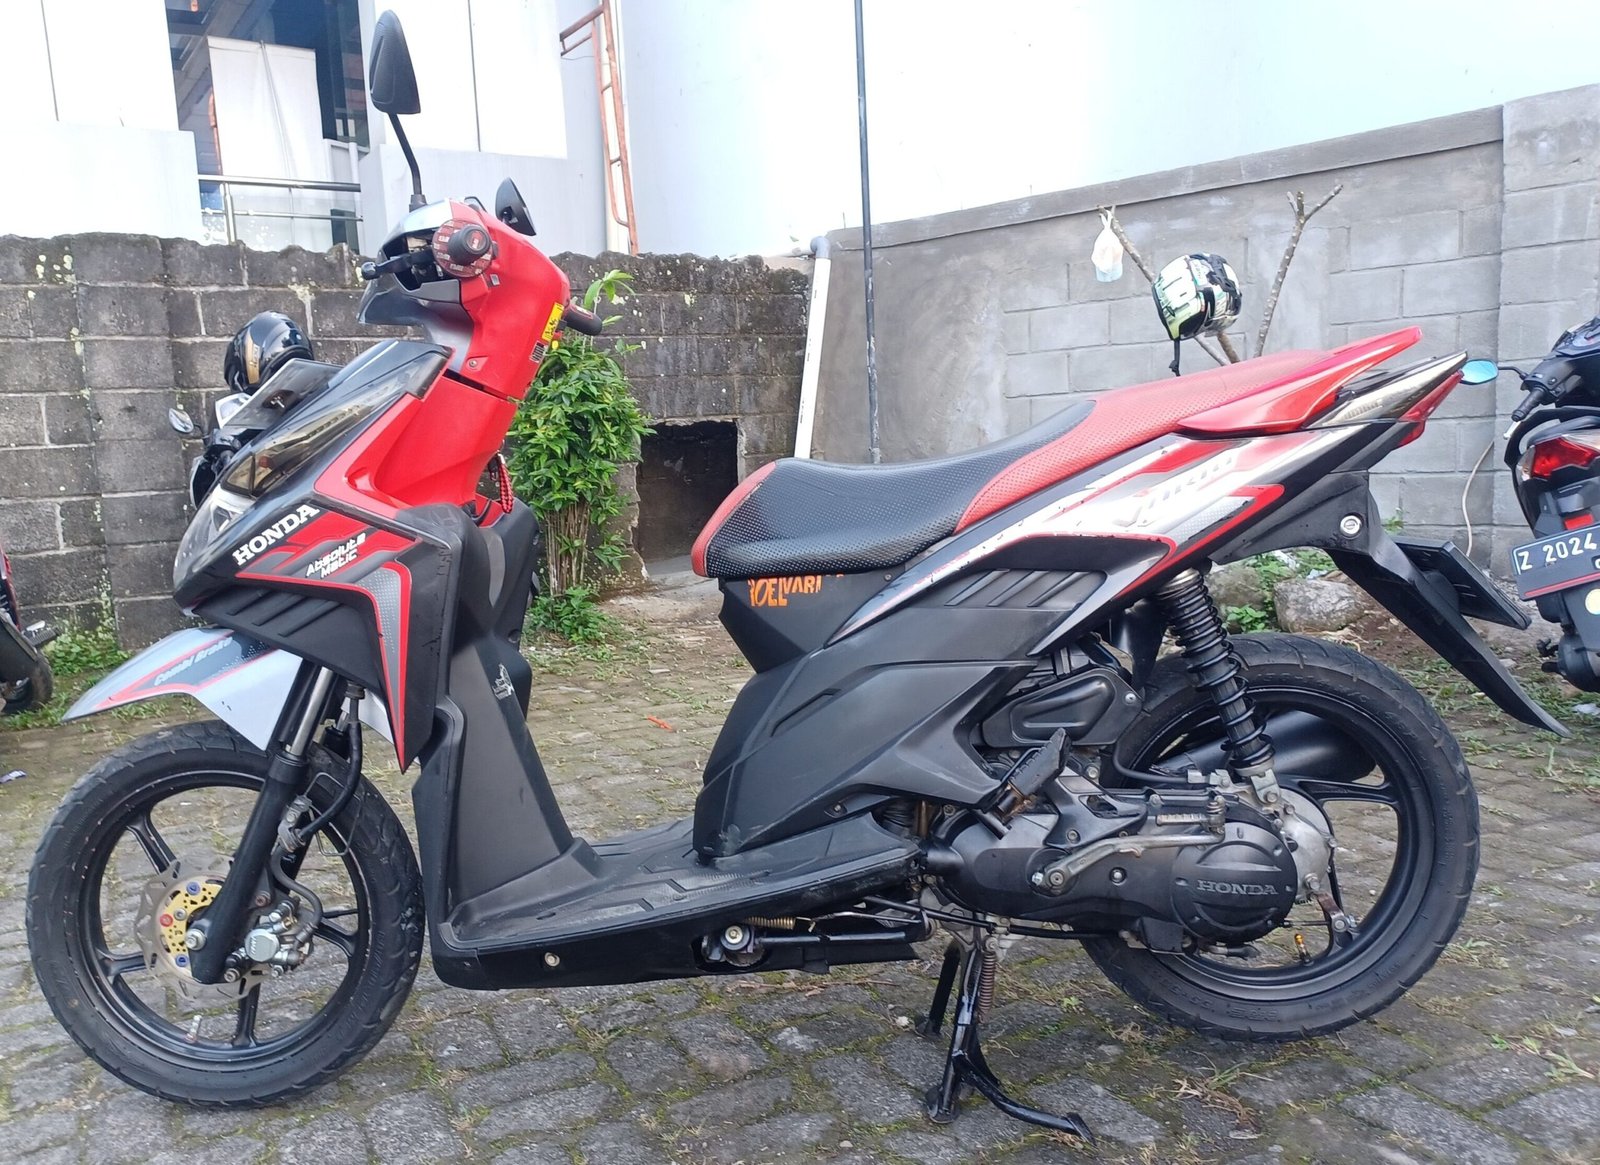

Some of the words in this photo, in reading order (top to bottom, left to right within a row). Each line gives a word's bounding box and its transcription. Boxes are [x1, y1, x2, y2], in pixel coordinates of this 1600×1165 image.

[232, 504, 320, 566] HONDA
[1519, 551, 1533, 570] Z
[1542, 532, 1597, 562] 2024
[320, 548, 358, 578] Matic
[1197, 879, 1279, 895] HONDA
